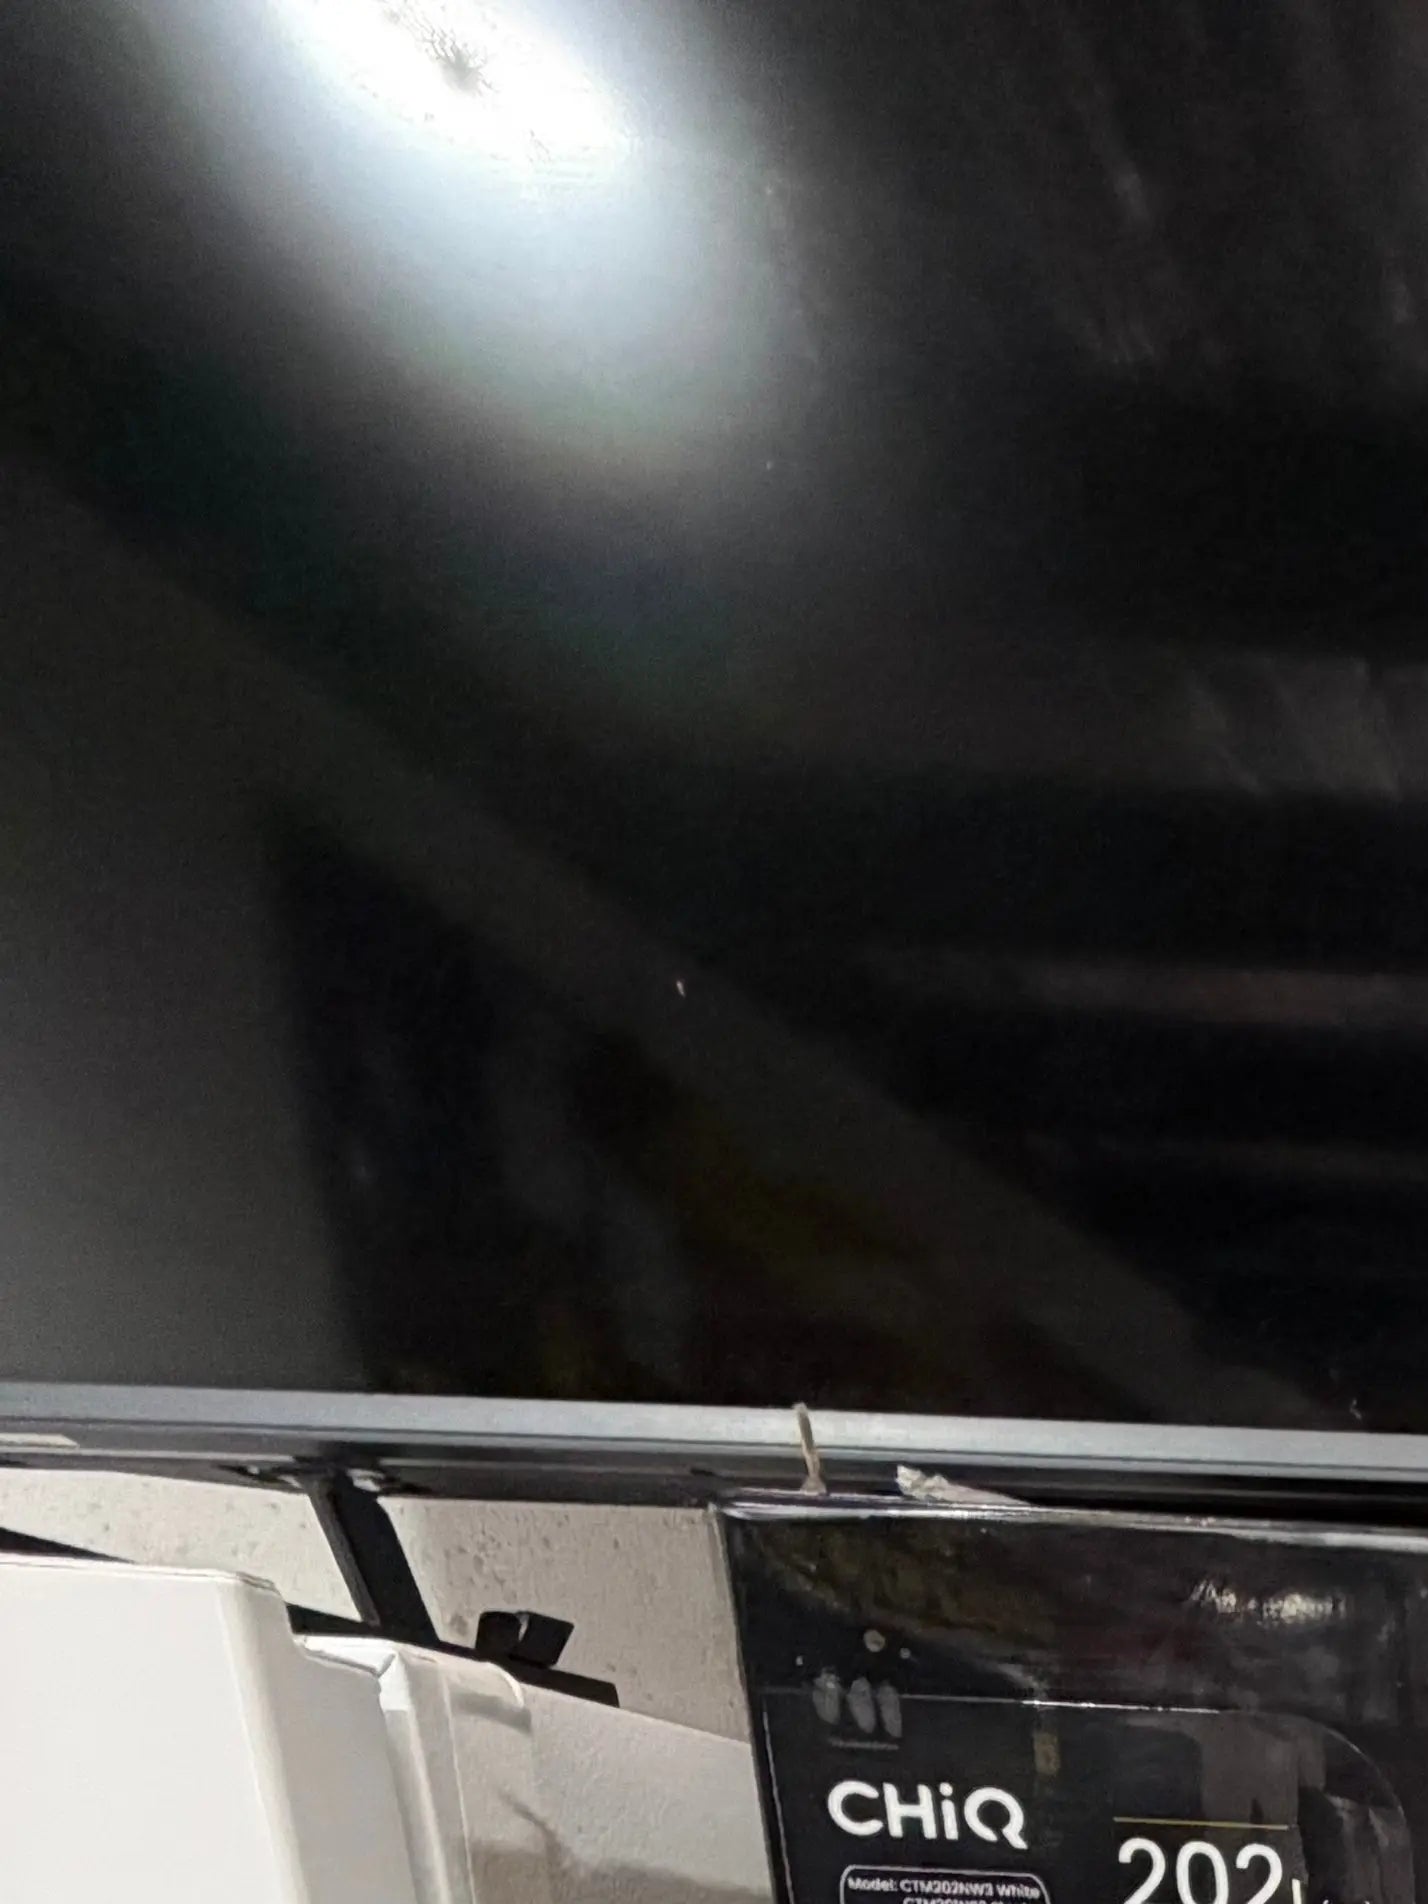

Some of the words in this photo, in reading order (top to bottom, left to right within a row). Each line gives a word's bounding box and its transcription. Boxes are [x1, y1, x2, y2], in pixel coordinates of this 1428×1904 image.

[828, 1779, 1028, 1849] CHiQ
[848, 1878, 897, 1892] Model:
[997, 1883, 1040, 1899] White
